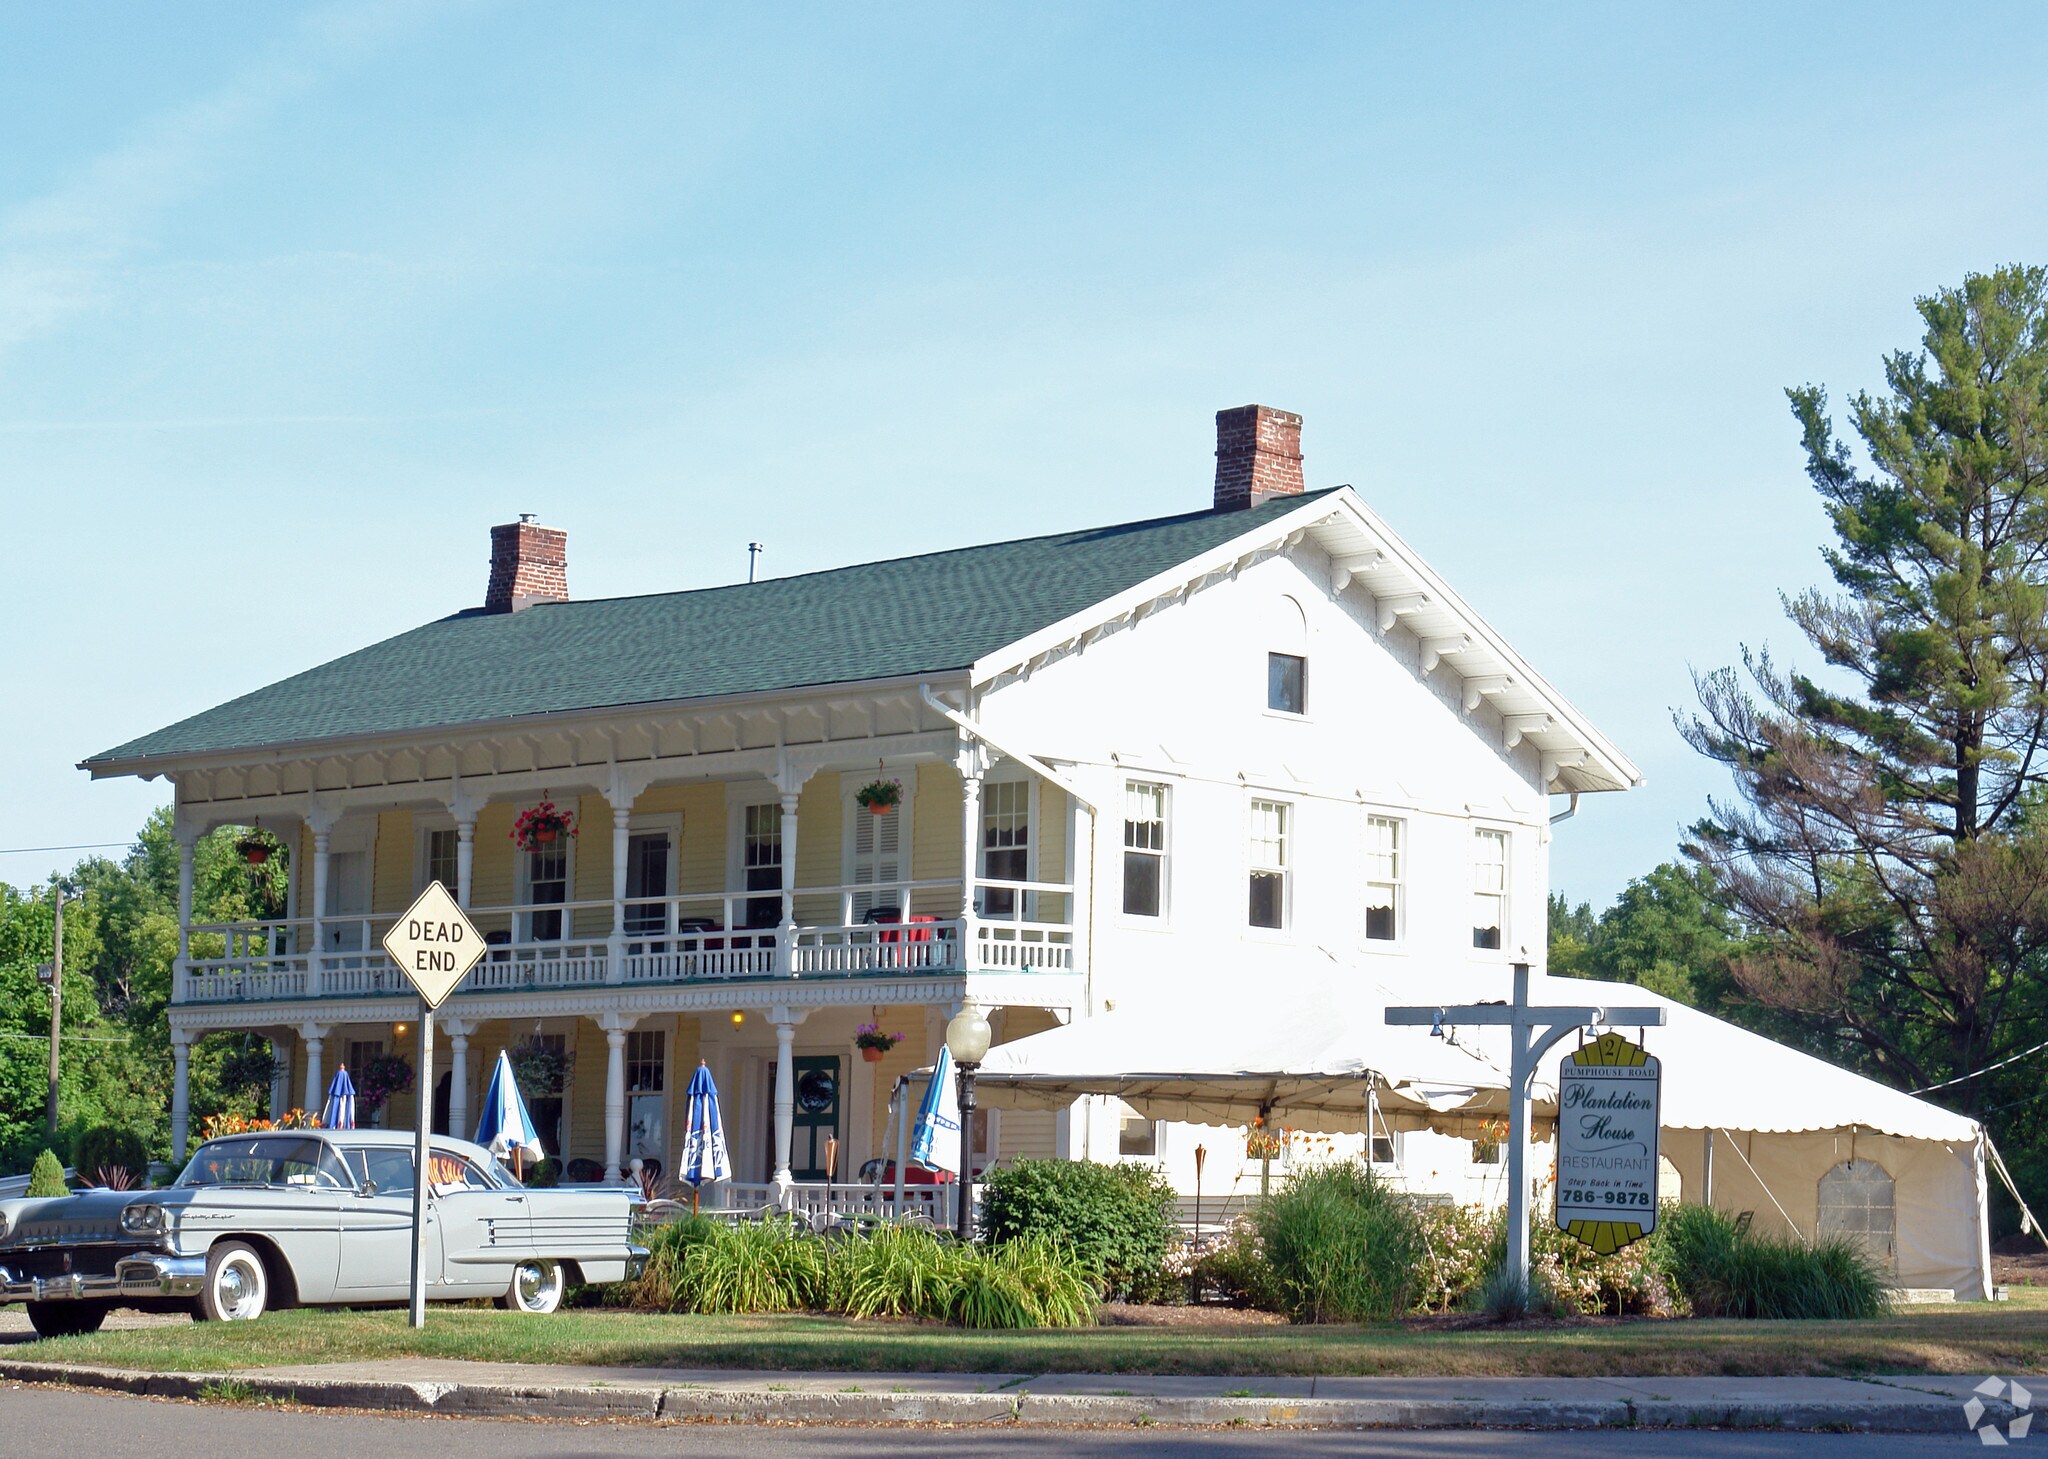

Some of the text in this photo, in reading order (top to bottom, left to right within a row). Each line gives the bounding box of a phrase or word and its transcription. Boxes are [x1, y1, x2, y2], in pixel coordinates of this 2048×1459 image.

[409, 921, 463, 942] DEAD
[417, 950, 456, 972] END
[1605, 1039, 1614, 1056] 2
[1564, 1068, 1655, 1078] PUMPHOUSE ROAD
[1563, 1083, 1652, 1110] Plantation
[1579, 1114, 1635, 1141] House
[428, 1156, 463, 1185] OR SALE
[1562, 1156, 1650, 1171] RESTAURANT
[1590, 1178, 1610, 1188] Back
[1613, 1179, 1621, 1188] in
[1562, 1189, 1650, 1206] 786-9878
